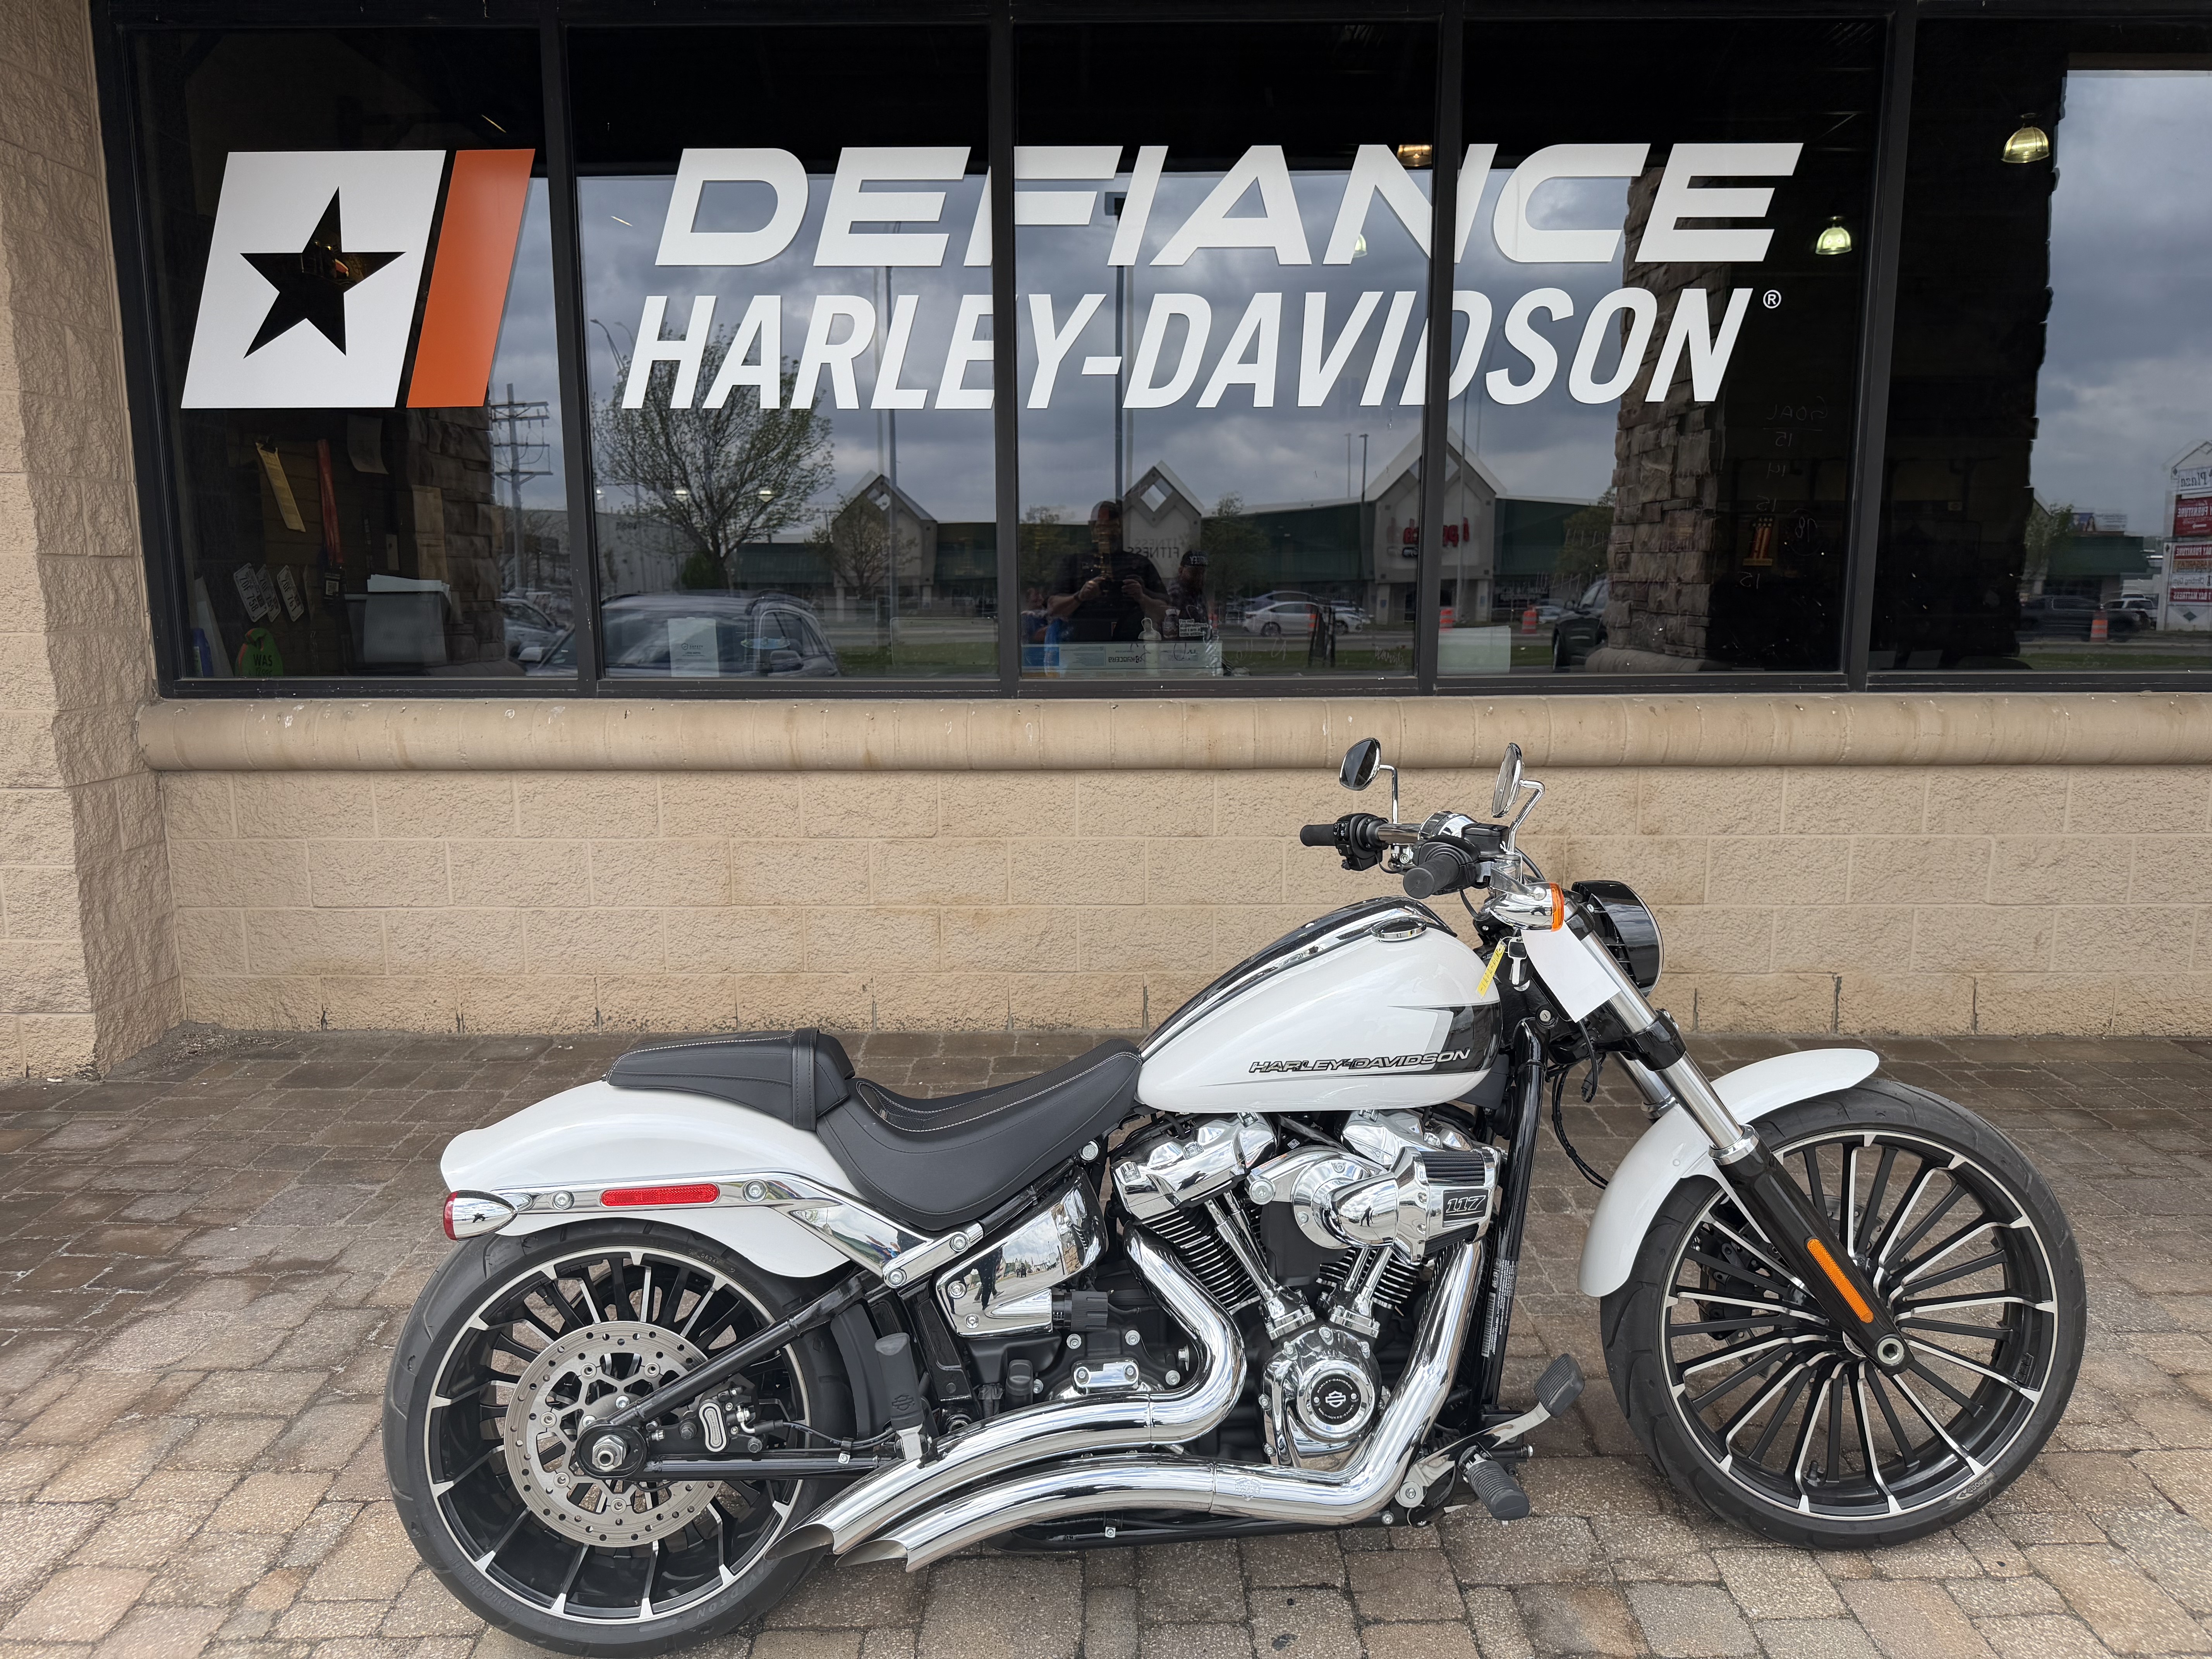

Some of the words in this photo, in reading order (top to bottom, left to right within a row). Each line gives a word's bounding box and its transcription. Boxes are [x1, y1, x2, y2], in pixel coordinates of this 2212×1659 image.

[654, 143, 1804, 266] DEFIANCE
[253, 654, 273, 666] WAS
[1248, 1048, 1471, 1073] HARLEY-DAVIDSON
[1445, 1195, 1489, 1214] 117
[701, 1253, 717, 1264] 0624
[1317, 1378, 1353, 1393] HARLEY-DAVIDSON
[1996, 1429, 2034, 1475] MICHELIN
[1968, 1477, 1989, 1494] front
[465, 1571, 524, 1617] SCORCHER
